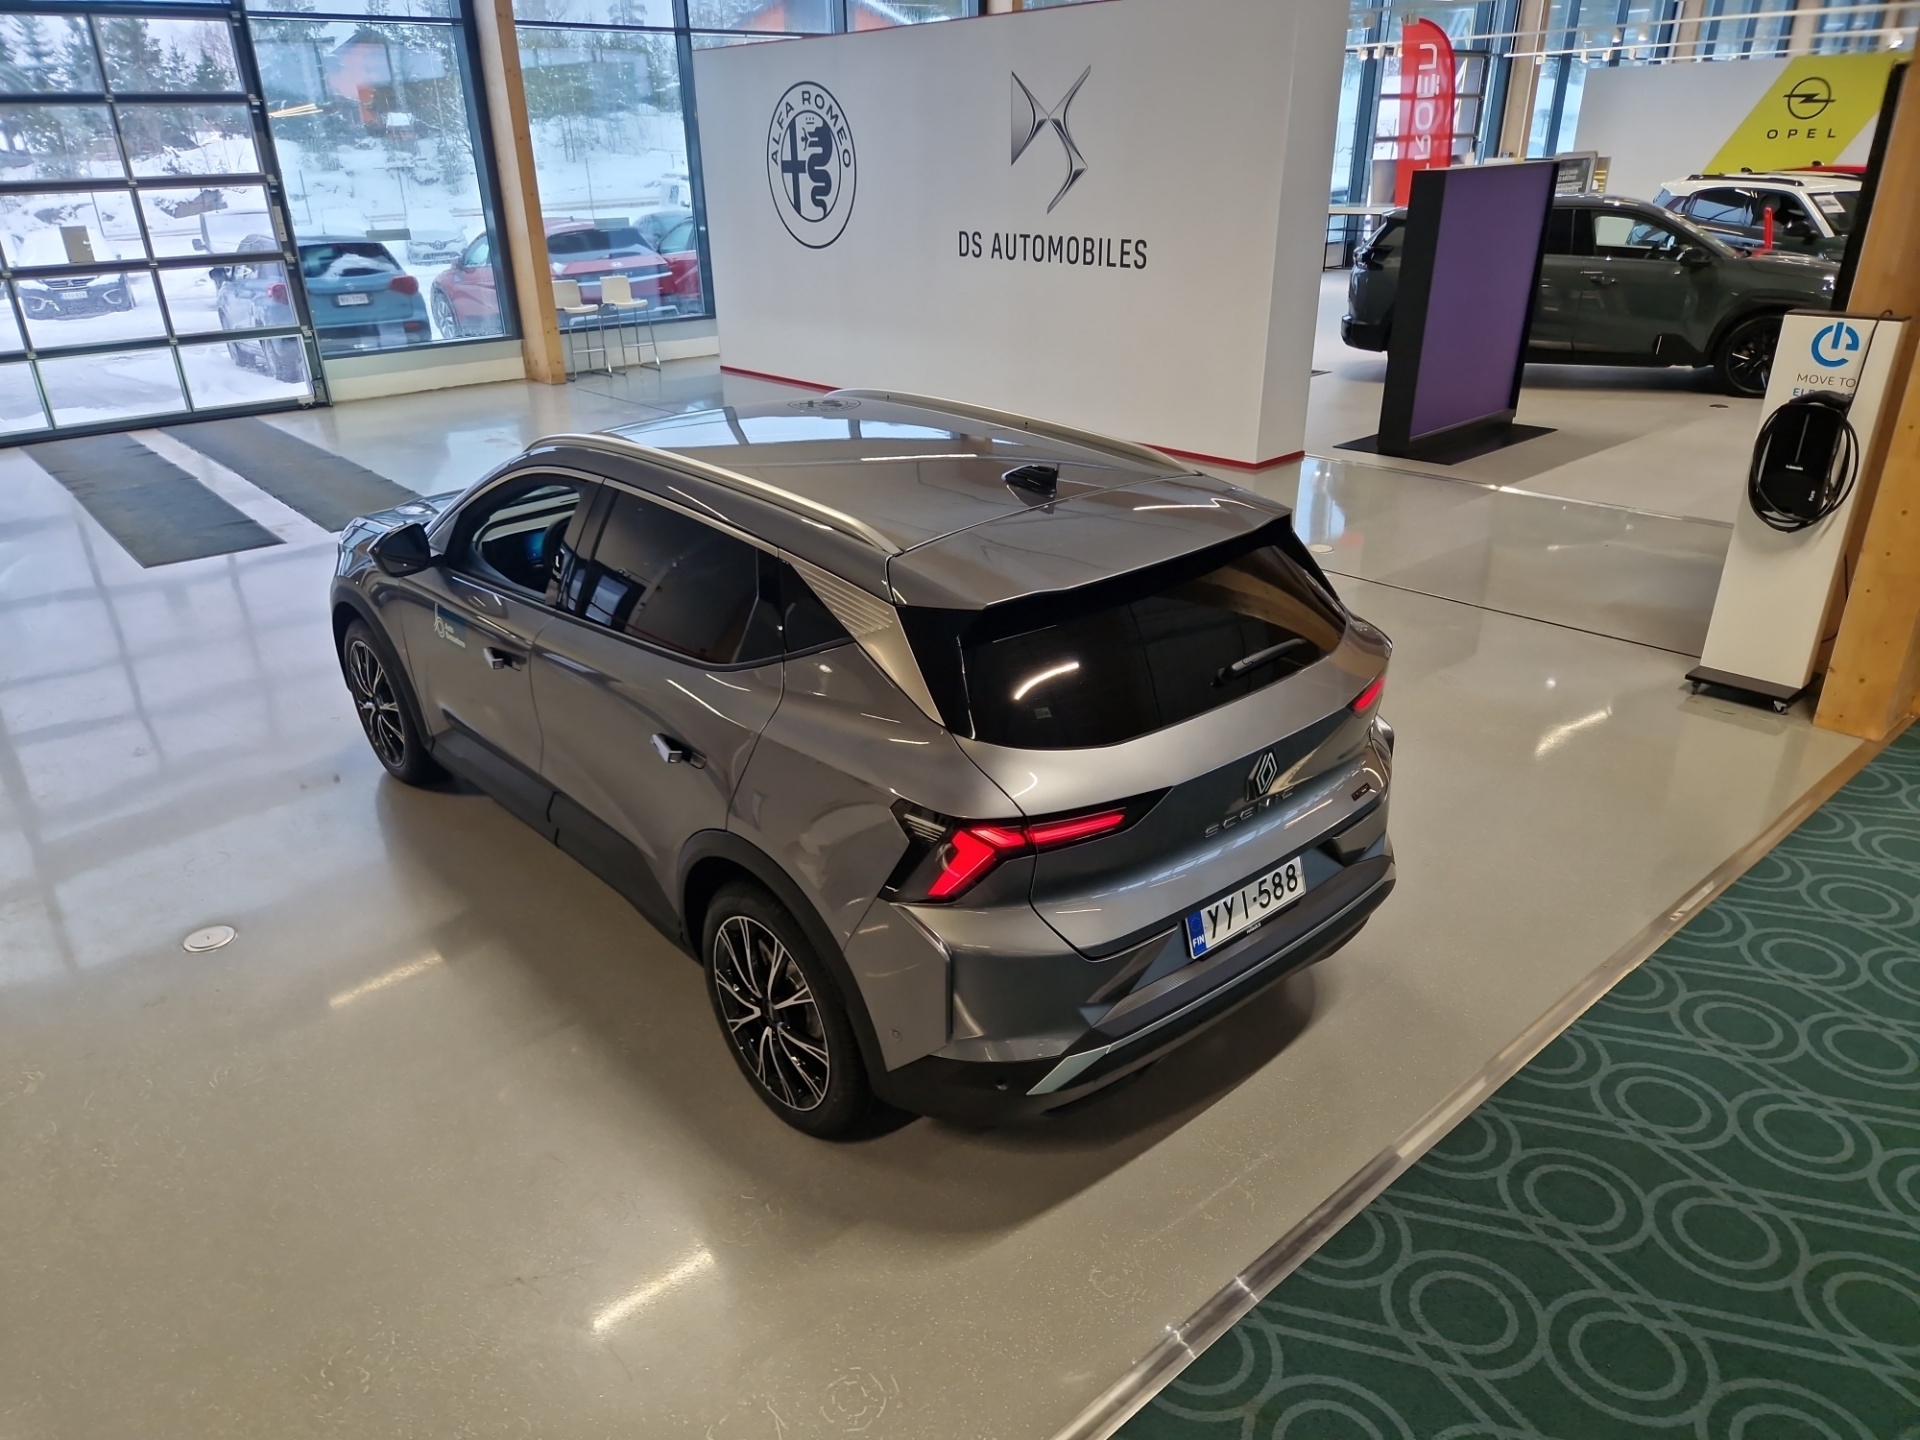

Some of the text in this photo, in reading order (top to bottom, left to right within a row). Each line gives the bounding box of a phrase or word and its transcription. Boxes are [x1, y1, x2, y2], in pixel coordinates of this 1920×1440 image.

[771, 90, 852, 168] ALFA ROMEO
[1766, 127, 1837, 140] OPEL
[958, 230, 1148, 270] DS AUTOMOBILES
[1796, 373, 1857, 388] MOVE TO
[1204, 785, 1295, 838] SCENIC
[1207, 863, 1298, 939] YYI-588
[1192, 934, 1205, 948] FIN
